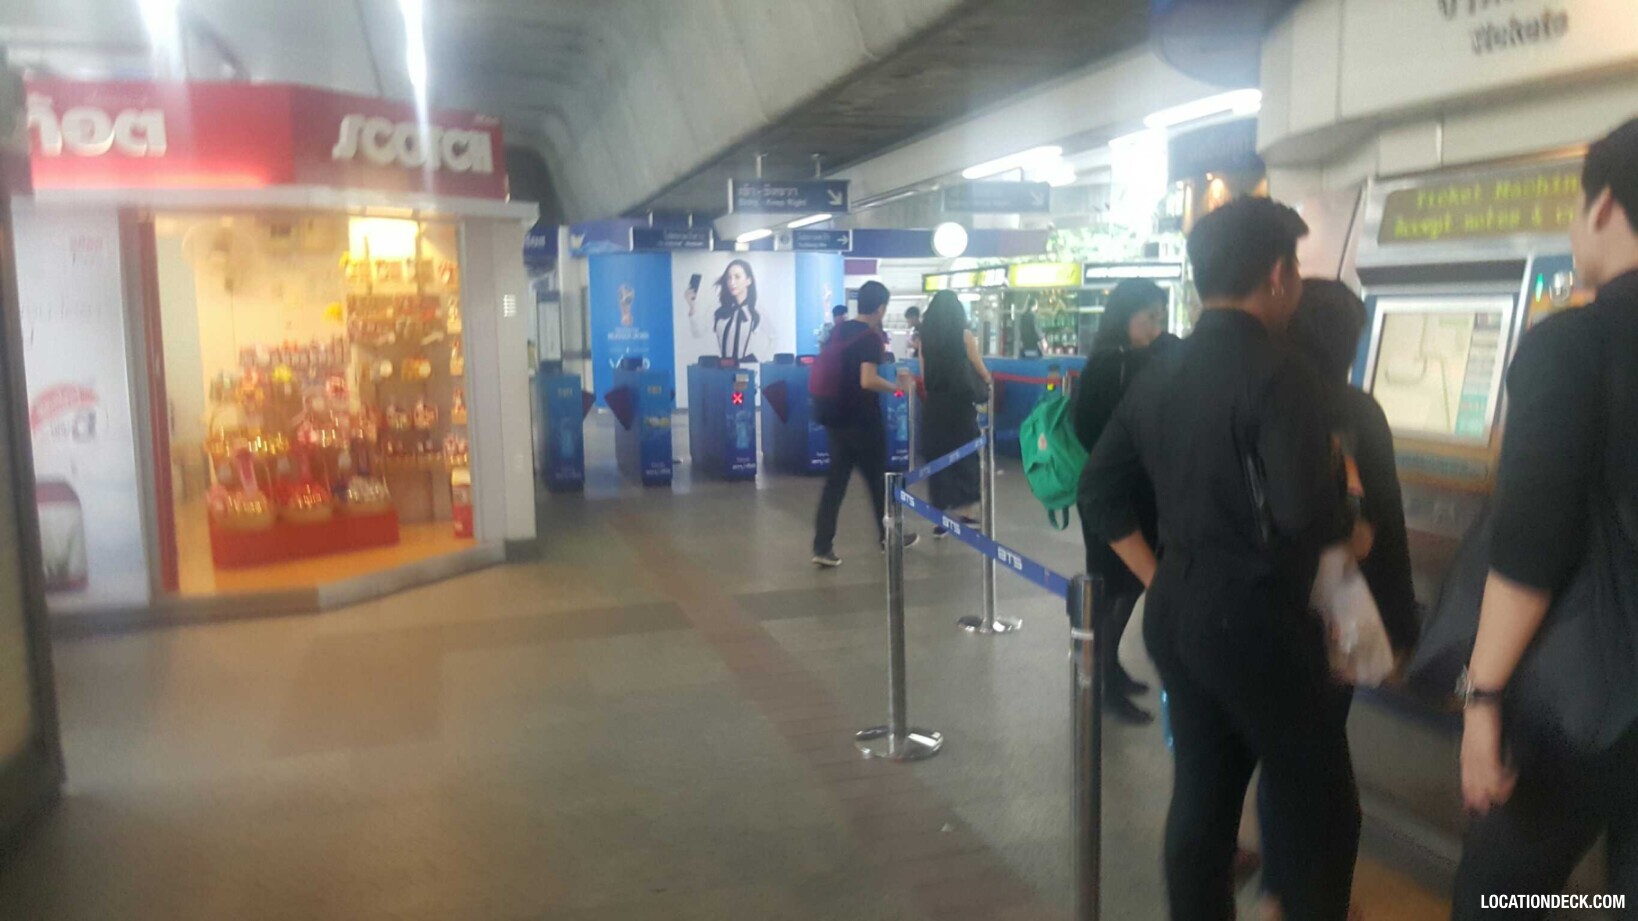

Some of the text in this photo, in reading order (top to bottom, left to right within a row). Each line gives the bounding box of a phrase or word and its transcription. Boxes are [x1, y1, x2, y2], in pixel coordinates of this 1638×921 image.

[1416, 174, 1579, 209] Ticket Machin
[1394, 212, 1451, 240] Accept
[1464, 205, 1520, 232] notes
[942, 515, 961, 535] BTS
[997, 547, 1023, 571] BTS
